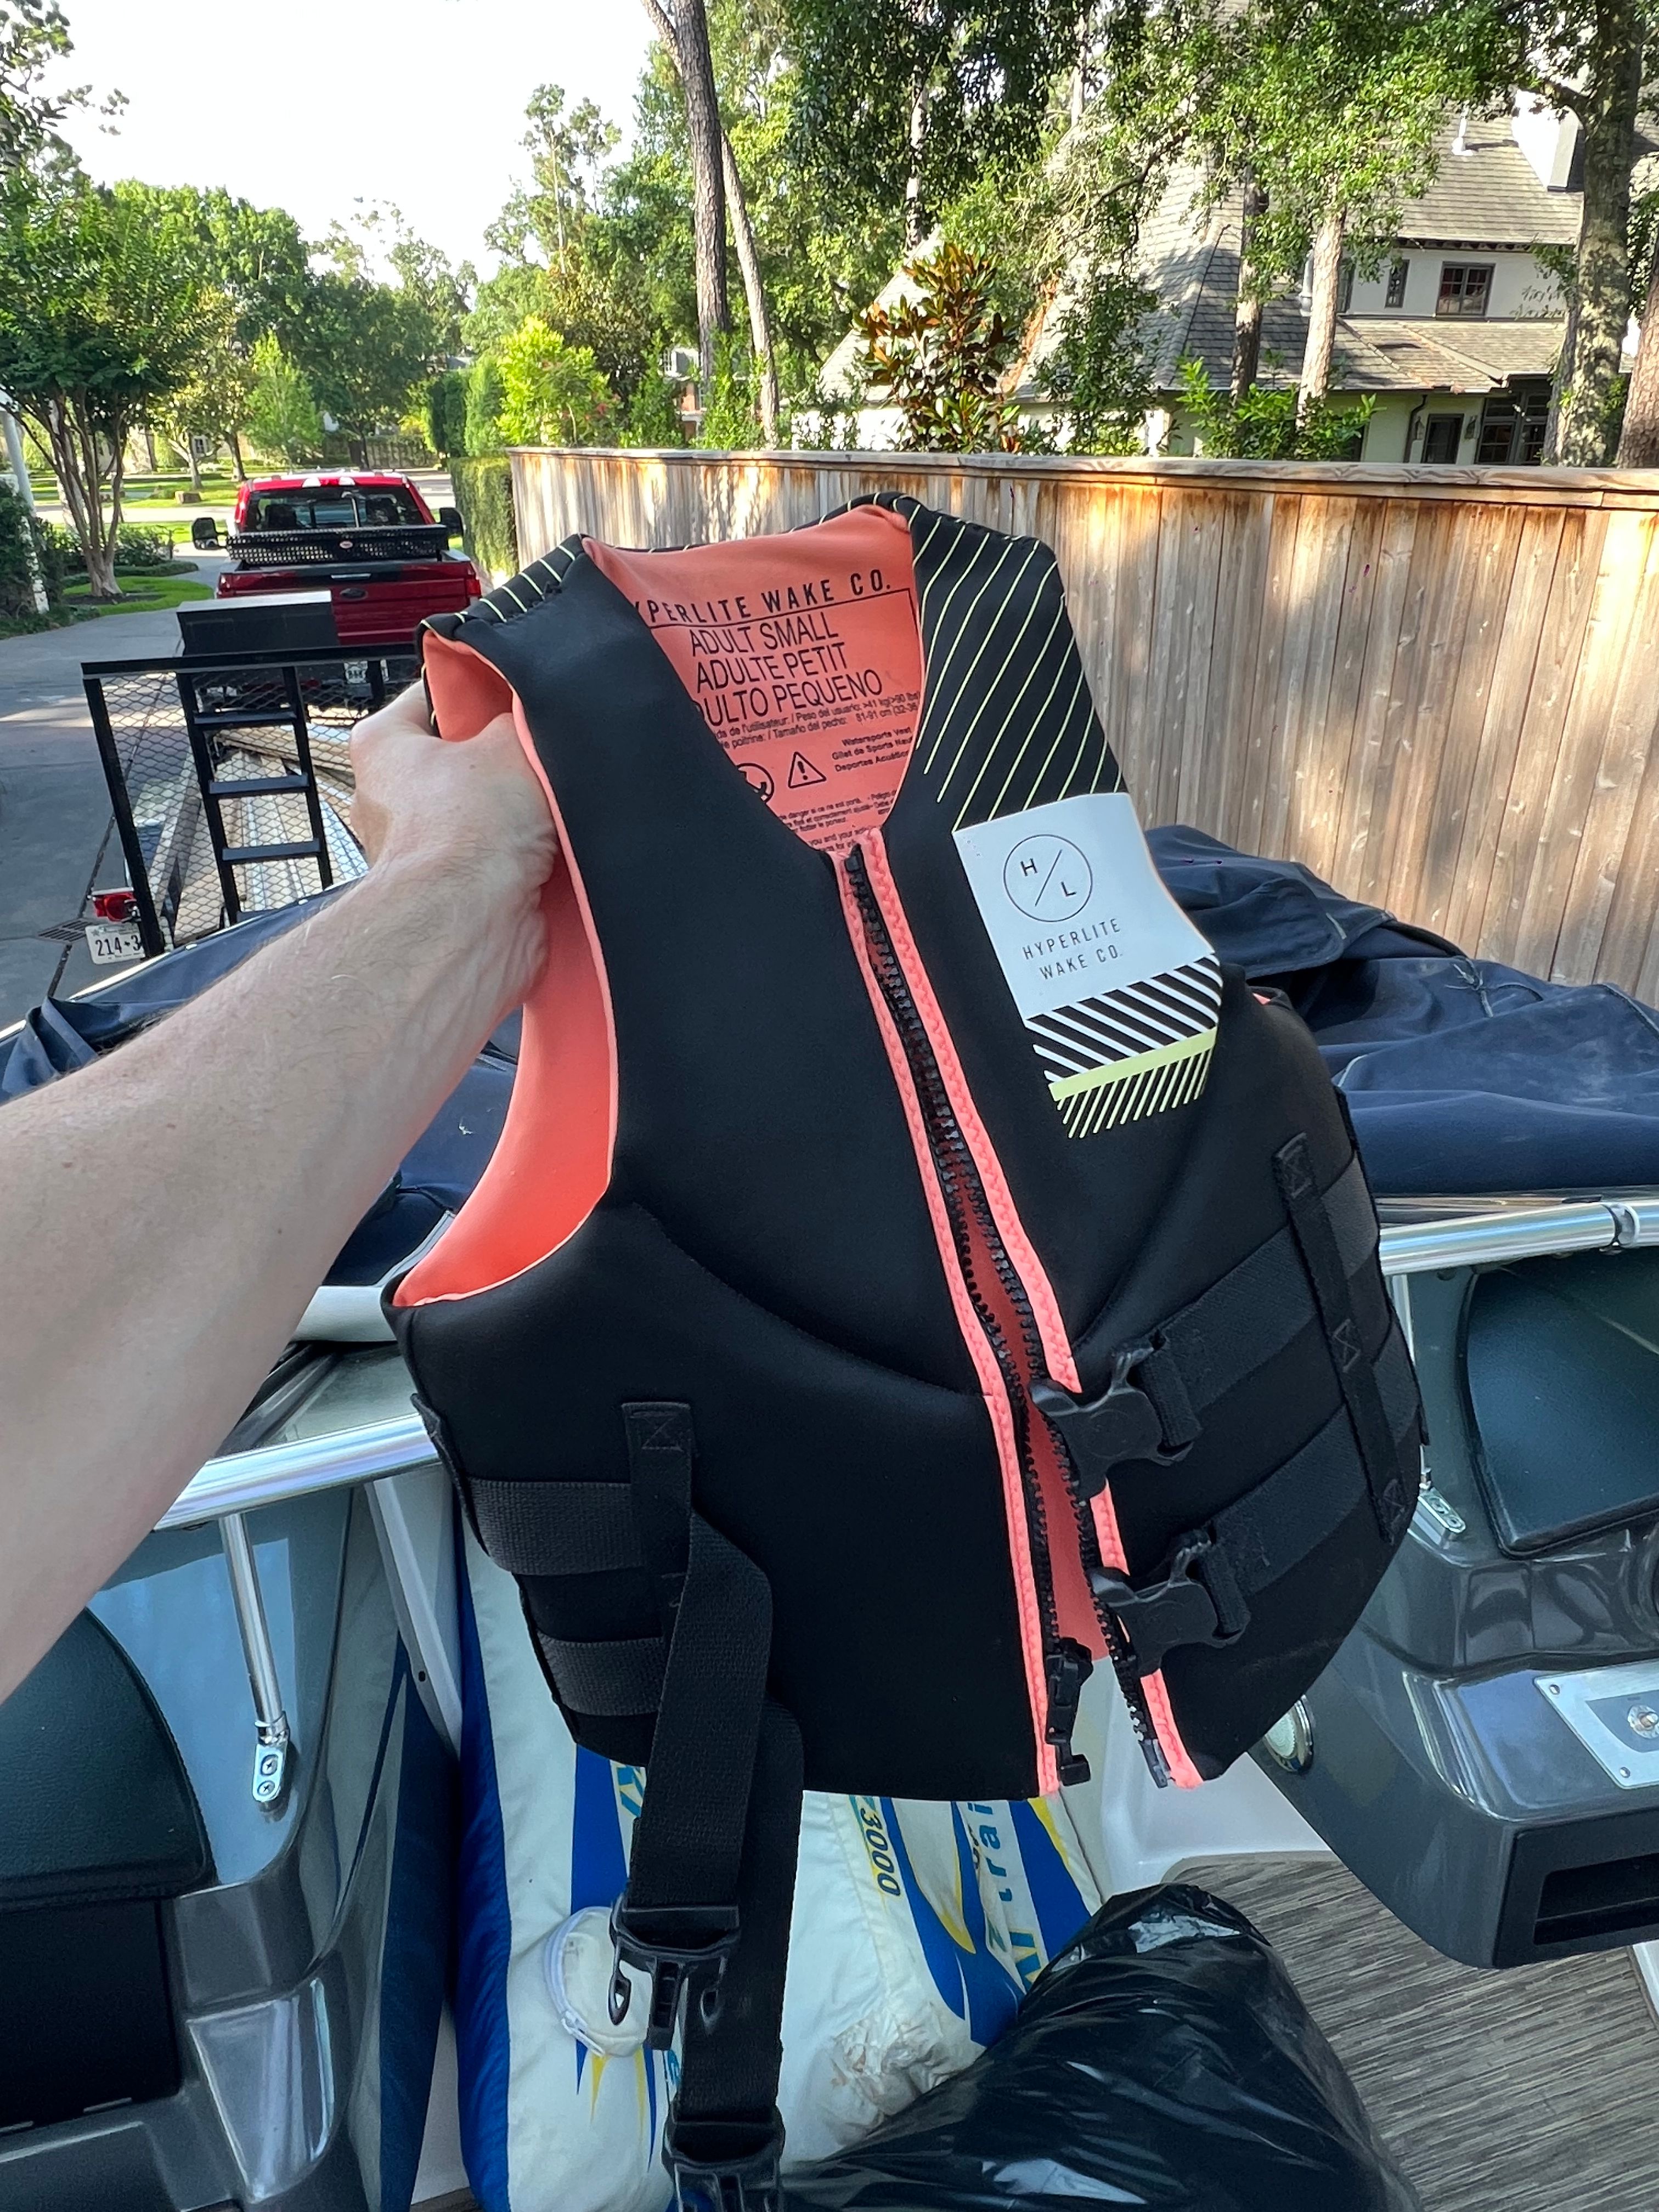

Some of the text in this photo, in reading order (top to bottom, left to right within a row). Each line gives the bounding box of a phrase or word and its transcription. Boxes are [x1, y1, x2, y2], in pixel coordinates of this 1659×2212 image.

[761, 579, 834, 613] WAKE
[850, 569, 890, 595] CO.
[690, 612, 838, 657] ADULT SMALL
[697, 642, 847, 693] ADULTE PETIT
[693, 669, 882, 726] ULTO PEQUENO
[796, 713, 816, 721] Peso
[819, 708, 830, 718] del
[808, 721, 820, 731] del
[1023, 918, 1121, 960] HYPERLITE
[1039, 944, 1124, 980] WAKE CO.
[860, 1808, 900, 1896] 3000
